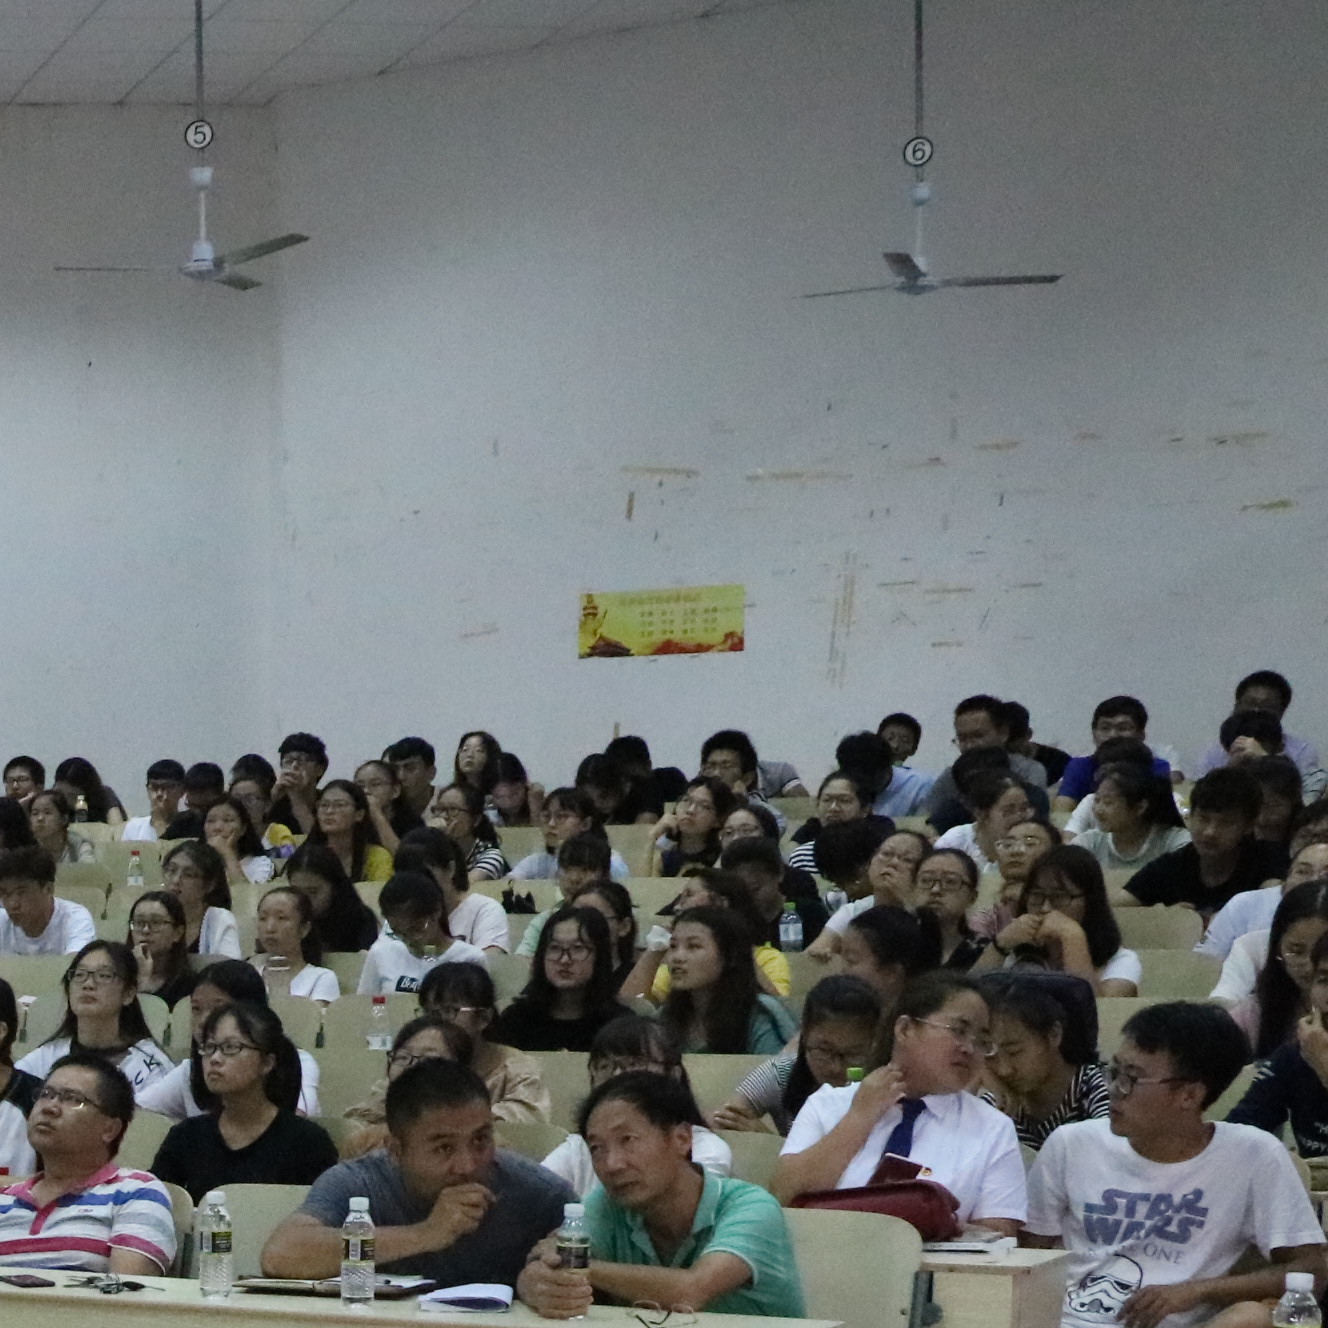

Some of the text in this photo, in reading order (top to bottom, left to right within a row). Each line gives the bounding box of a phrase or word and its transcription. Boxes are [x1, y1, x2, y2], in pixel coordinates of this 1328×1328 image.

[193, 124, 206, 145] 5
[912, 141, 926, 161] 6
[1084, 1188, 1209, 1220] STAR
[1084, 1215, 1206, 1245] WARS
[1143, 1241, 1184, 1265] ONE
